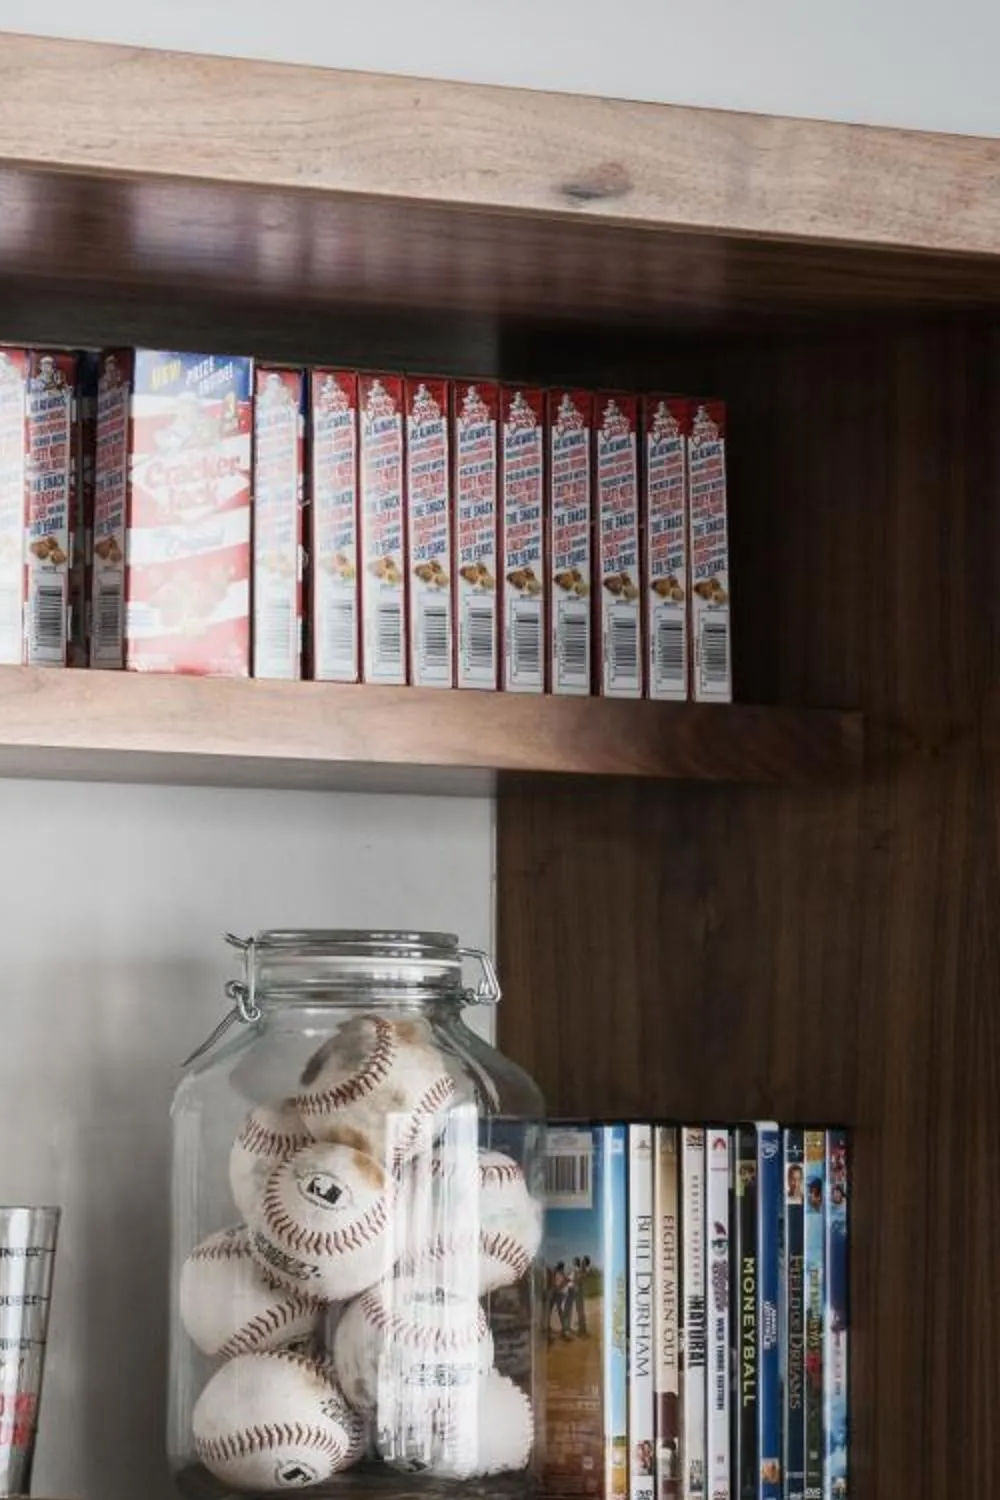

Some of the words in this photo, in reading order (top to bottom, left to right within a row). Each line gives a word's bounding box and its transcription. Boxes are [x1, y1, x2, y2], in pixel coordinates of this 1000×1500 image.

[663, 1215, 675, 1272] EIGHT
[635, 1272, 652, 1377] DURHAM
[663, 1280, 675, 1321] MEN
[688, 1299, 705, 1369] NATURAL
[743, 1257, 756, 1407] MONEYBALL
[663, 1327, 675, 1368] OUT
[790, 1332, 804, 1409] DREAMS
